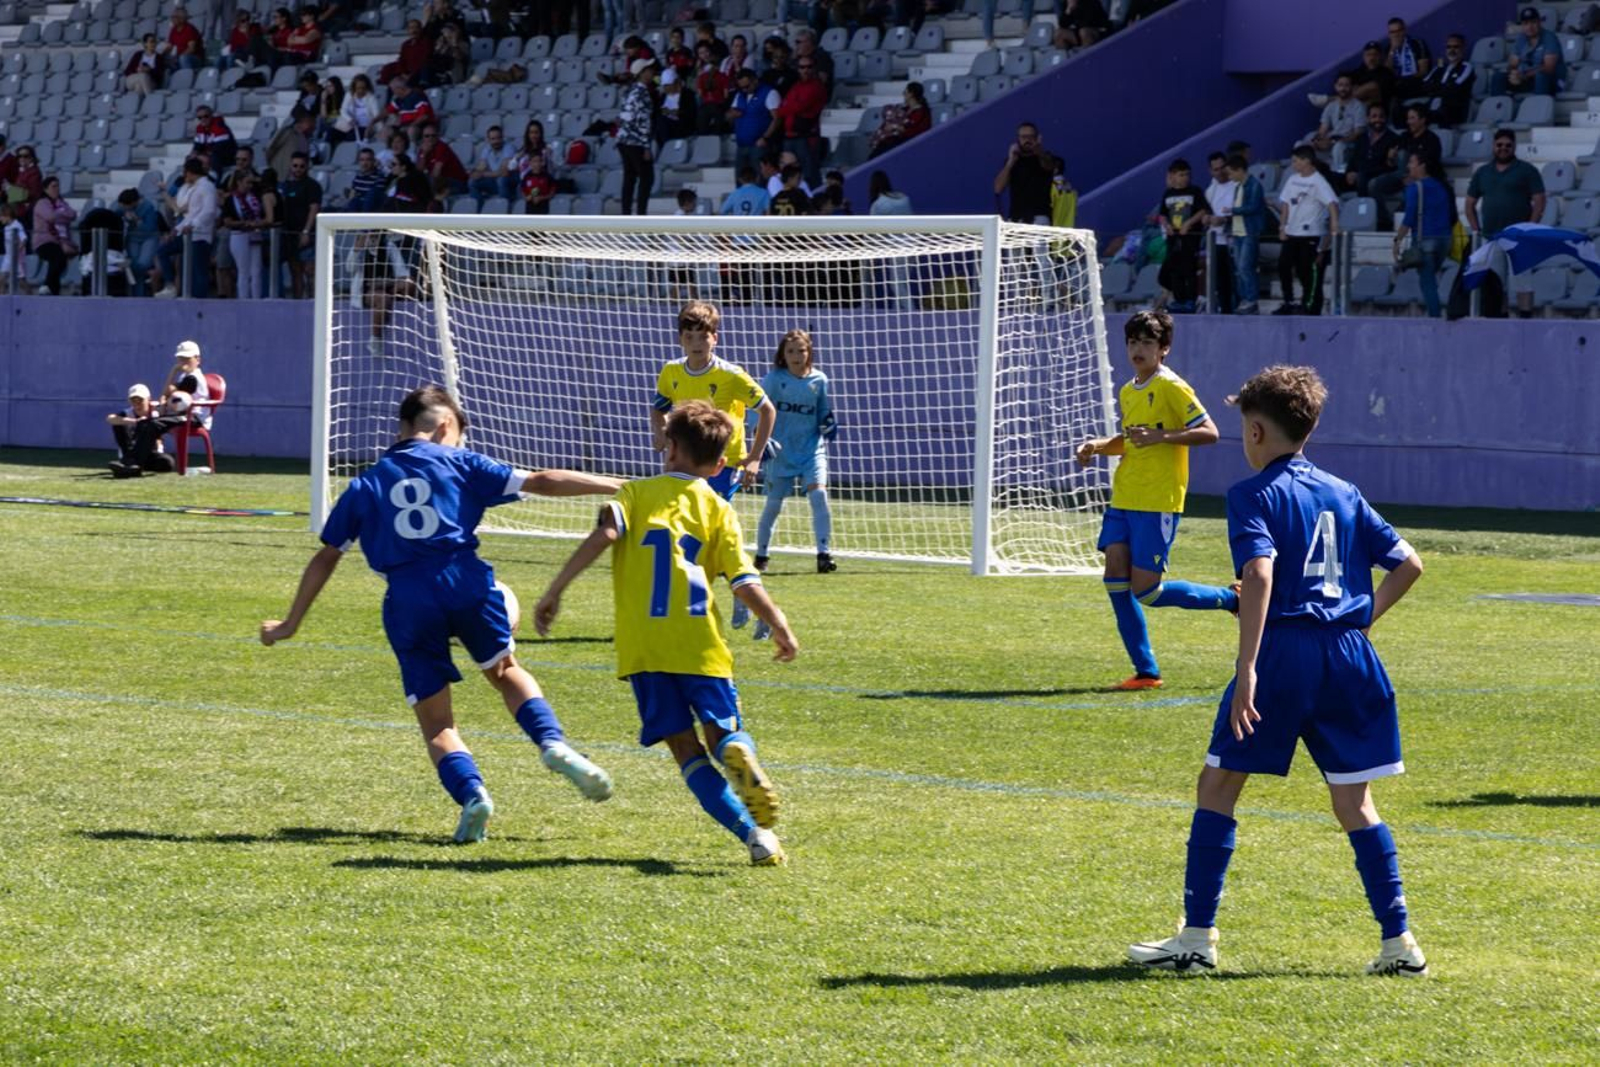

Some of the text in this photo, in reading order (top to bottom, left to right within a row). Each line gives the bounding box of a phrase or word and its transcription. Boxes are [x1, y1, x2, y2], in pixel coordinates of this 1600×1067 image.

[741, 200, 752, 216] 9
[777, 401, 816, 416] DIGI
[389, 477, 440, 540] 8
[640, 527, 708, 618] 11
[1303, 511, 1343, 599] 4
